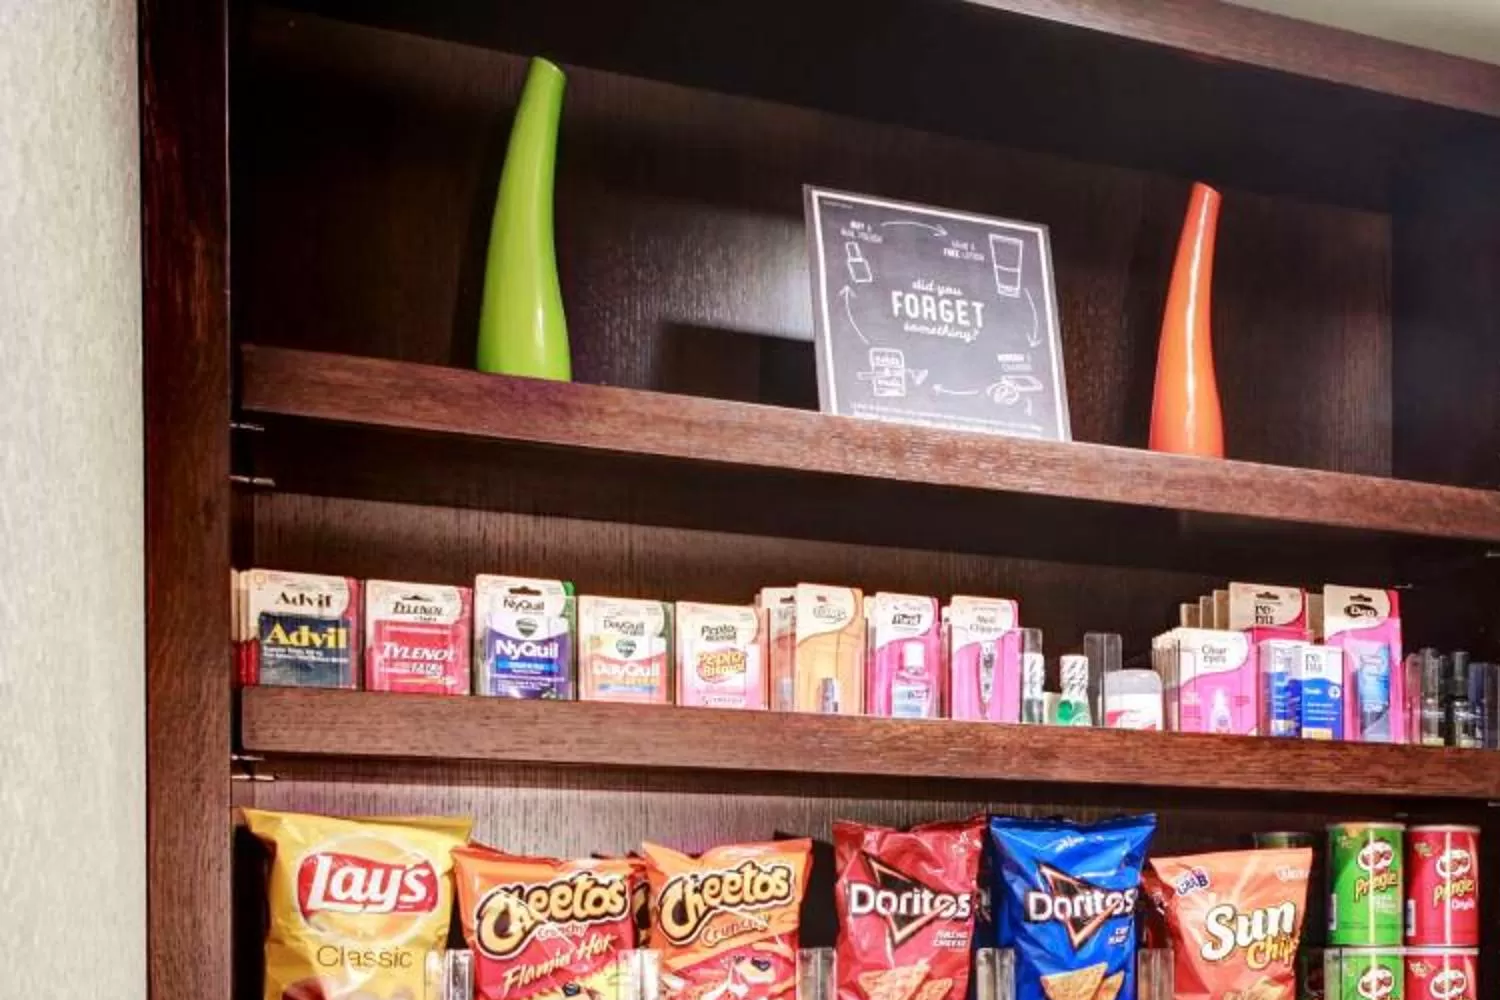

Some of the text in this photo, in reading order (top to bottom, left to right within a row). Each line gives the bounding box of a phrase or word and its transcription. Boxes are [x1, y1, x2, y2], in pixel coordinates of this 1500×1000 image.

[891, 291, 985, 328] FORGET
[275, 591, 332, 608] Advil
[503, 598, 545, 613] NyQuil
[264, 622, 347, 649] Advil
[382, 642, 456, 661] TYLENOL
[496, 639, 559, 660] NyQuil
[592, 660, 661, 678] DayQuil
[477, 871, 627, 956] Cheetos
[660, 861, 793, 944] Cheetos
[850, 882, 973, 919] Doritos
[1028, 886, 1138, 922] Doritos
[1200, 901, 1297, 961] Sun
[316, 945, 413, 969] Classic
